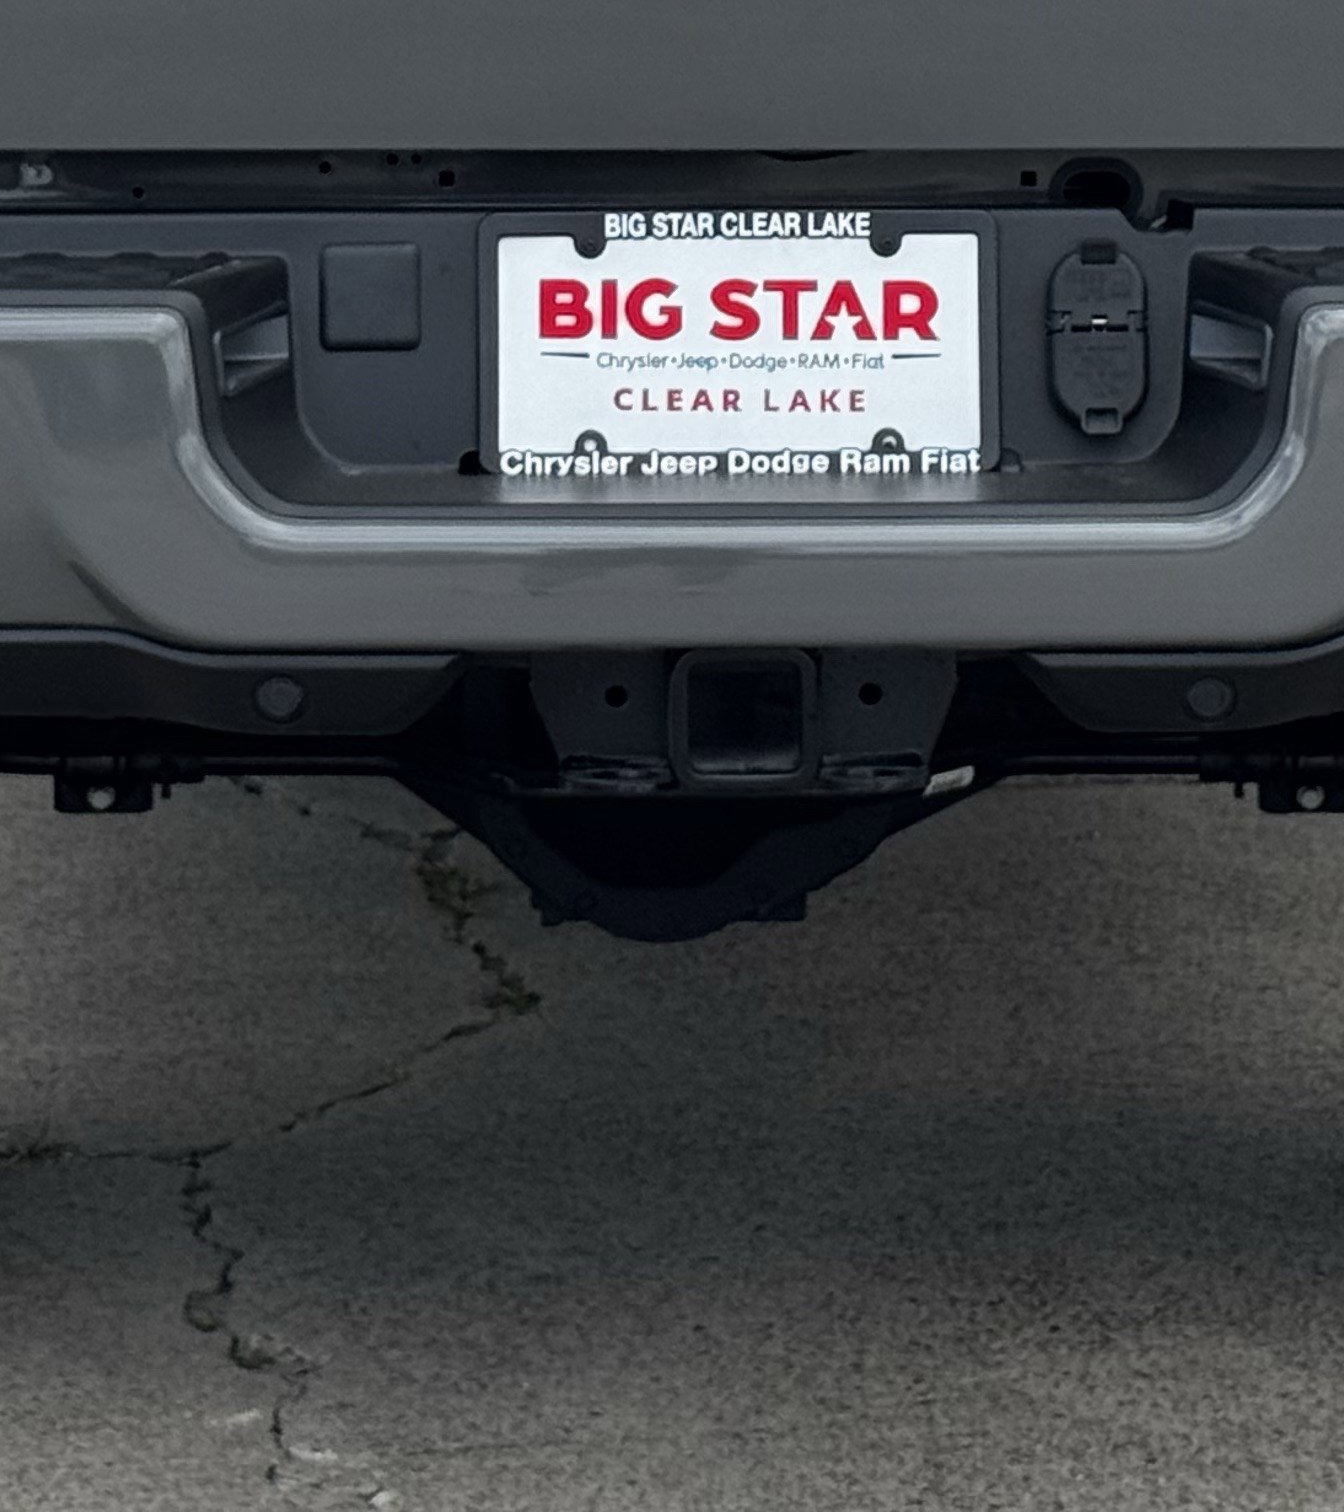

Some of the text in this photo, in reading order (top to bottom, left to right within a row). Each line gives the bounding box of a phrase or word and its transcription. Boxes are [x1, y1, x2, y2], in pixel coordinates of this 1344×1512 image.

[605, 213, 871, 237] BIG STAR CLEAR LAKE
[539, 278, 940, 340] BIG STAR
[613, 389, 867, 412] CLEAR LAKE
[499, 447, 982, 476] Chrysler Jeep Dodge Ram Fiat
